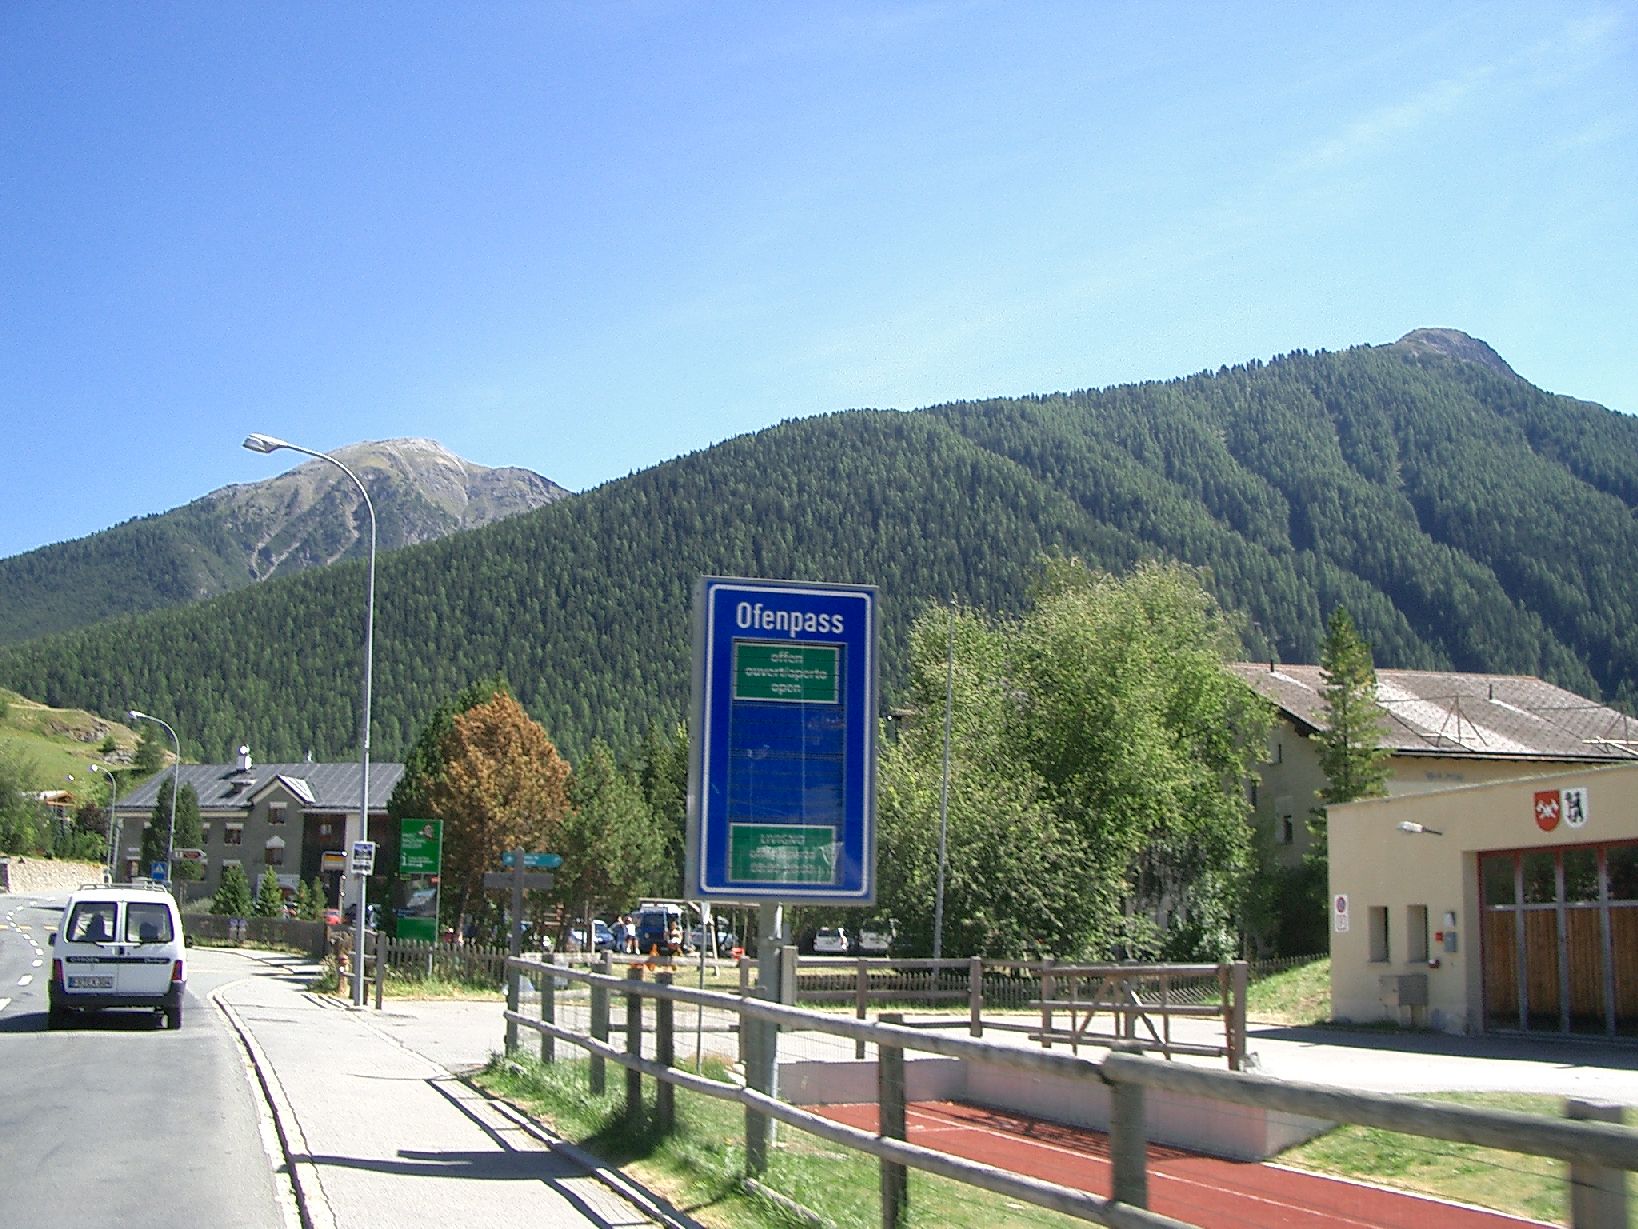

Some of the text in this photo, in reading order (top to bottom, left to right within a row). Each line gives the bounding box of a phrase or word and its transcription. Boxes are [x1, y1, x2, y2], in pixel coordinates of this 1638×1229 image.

[736, 602, 844, 638] Ofenpass
[770, 651, 804, 664] offen
[770, 683, 802, 695] open
